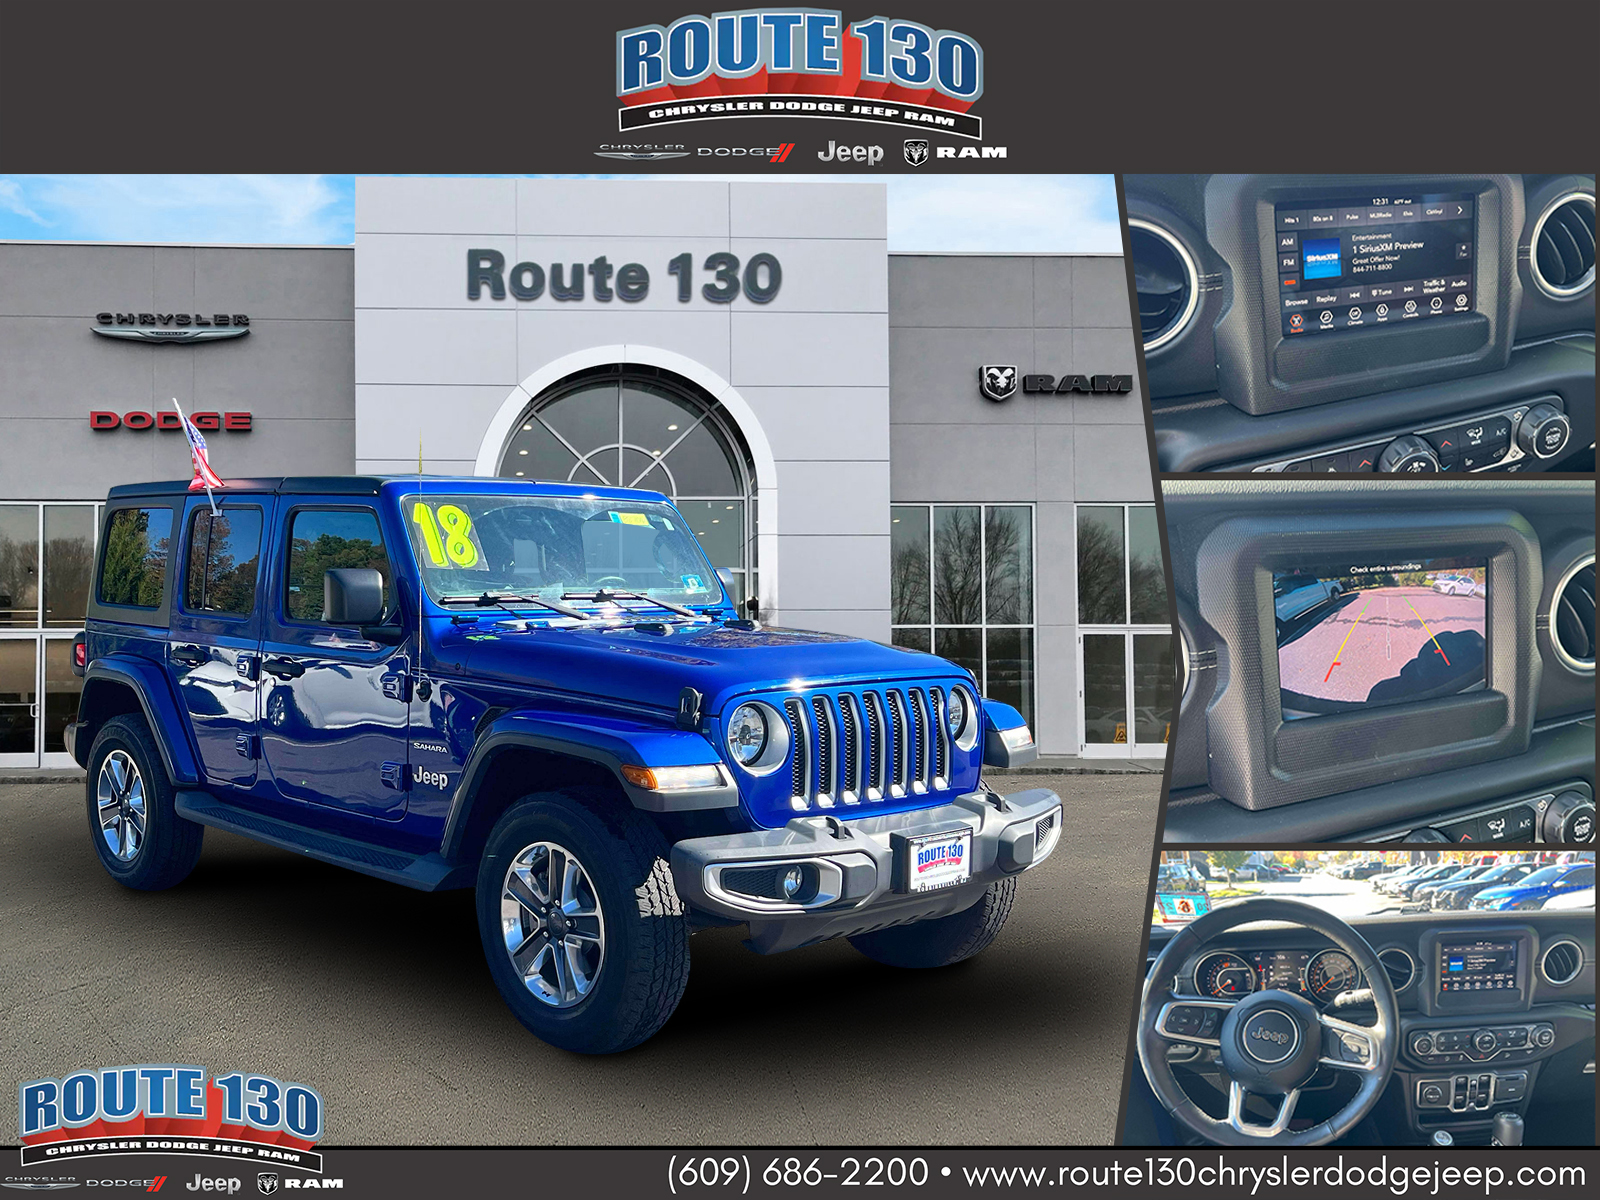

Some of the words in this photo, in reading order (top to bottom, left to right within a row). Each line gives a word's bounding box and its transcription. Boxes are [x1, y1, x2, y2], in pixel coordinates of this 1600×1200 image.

[1281, 238, 1295, 246] AM
[1352, 232, 1392, 241] Entertainment
[1359, 243, 1393, 253] SiriusXM
[1394, 240, 1425, 251] Preview
[1283, 259, 1295, 267] FM
[1352, 257, 1369, 266] Great
[1369, 256, 1385, 264] Offer
[466, 248, 650, 302] Route
[667, 252, 783, 305] 130
[1451, 280, 1468, 288] Audio
[1378, 288, 1393, 296] Tune
[1422, 286, 1446, 294] Weather
[1284, 298, 1309, 308] Browse
[1315, 294, 1337, 304] Replay
[95, 312, 250, 326] CHRYSLER
[1022, 374, 1134, 393] RAM
[90, 411, 252, 432] DODGE
[413, 502, 478, 568] 18
[1350, 565, 1368, 574] Check
[1386, 563, 1422, 571] surroundings
[414, 742, 448, 753] SAHARA
[413, 765, 448, 790] Jeep
[1519, 818, 1531, 829] A/C
[918, 846, 946, 865] ROUTE
[947, 844, 964, 857] 130
[1251, 1026, 1289, 1045] Jeep
